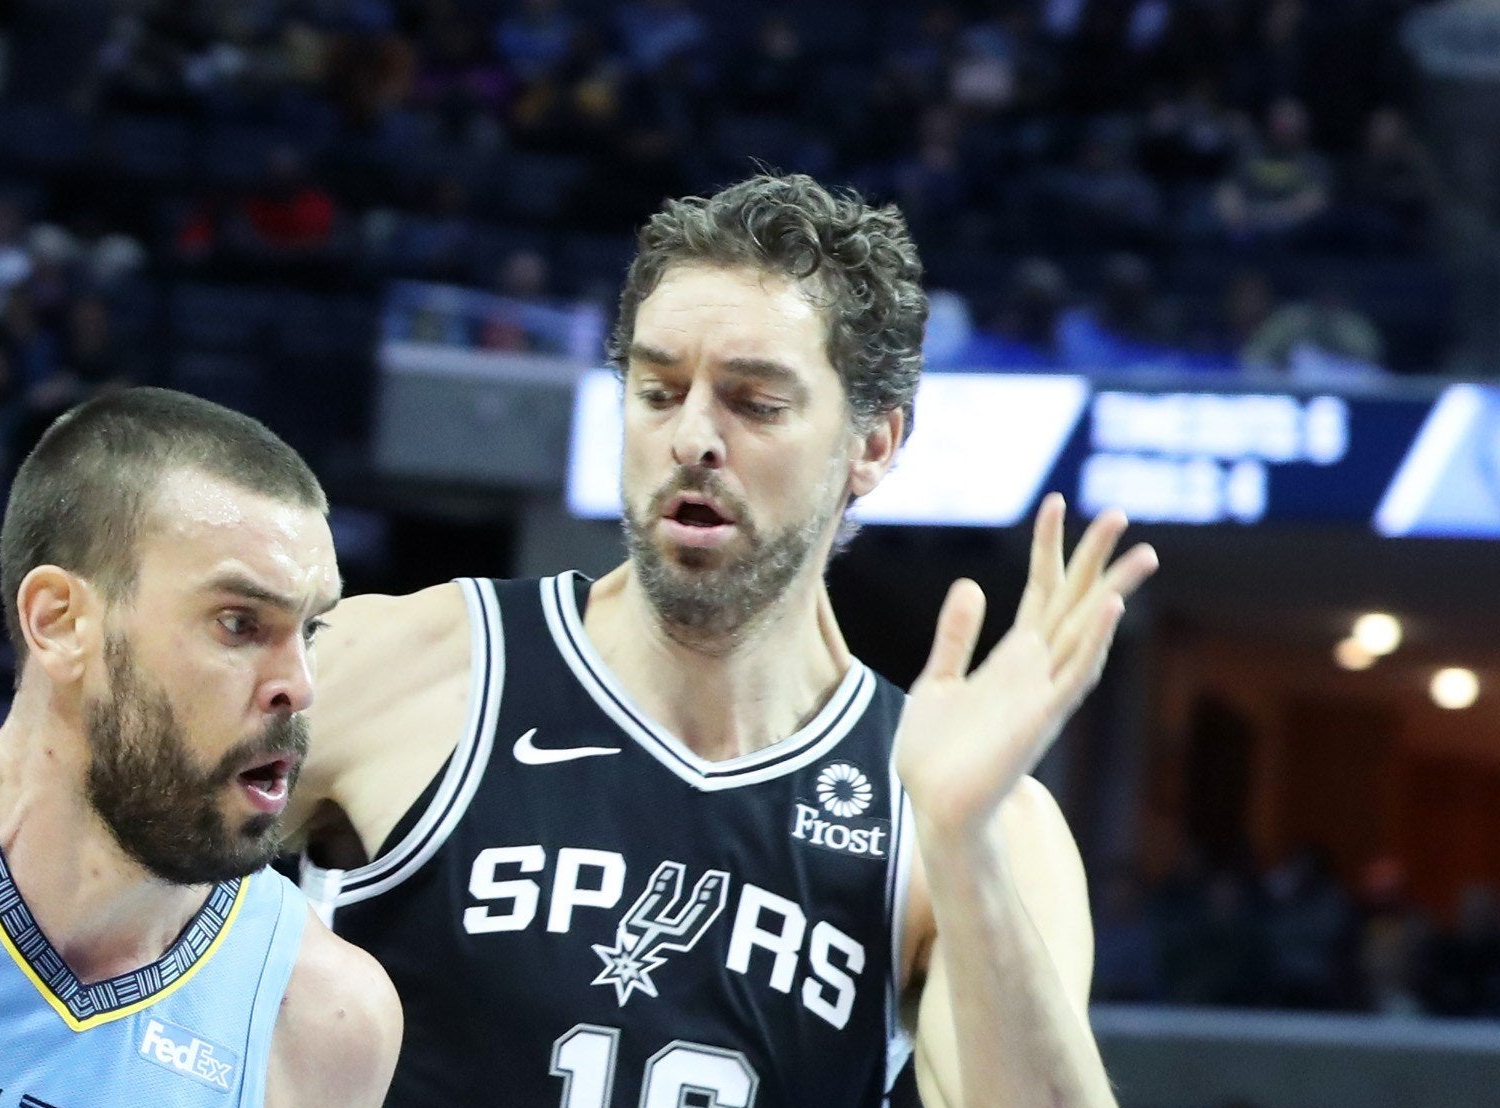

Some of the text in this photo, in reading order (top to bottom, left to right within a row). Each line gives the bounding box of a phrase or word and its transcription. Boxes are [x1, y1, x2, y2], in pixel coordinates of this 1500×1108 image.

[791, 803, 887, 856] Frost
[462, 844, 866, 1031] SPURS
[140, 1019, 233, 1088] FedEx
